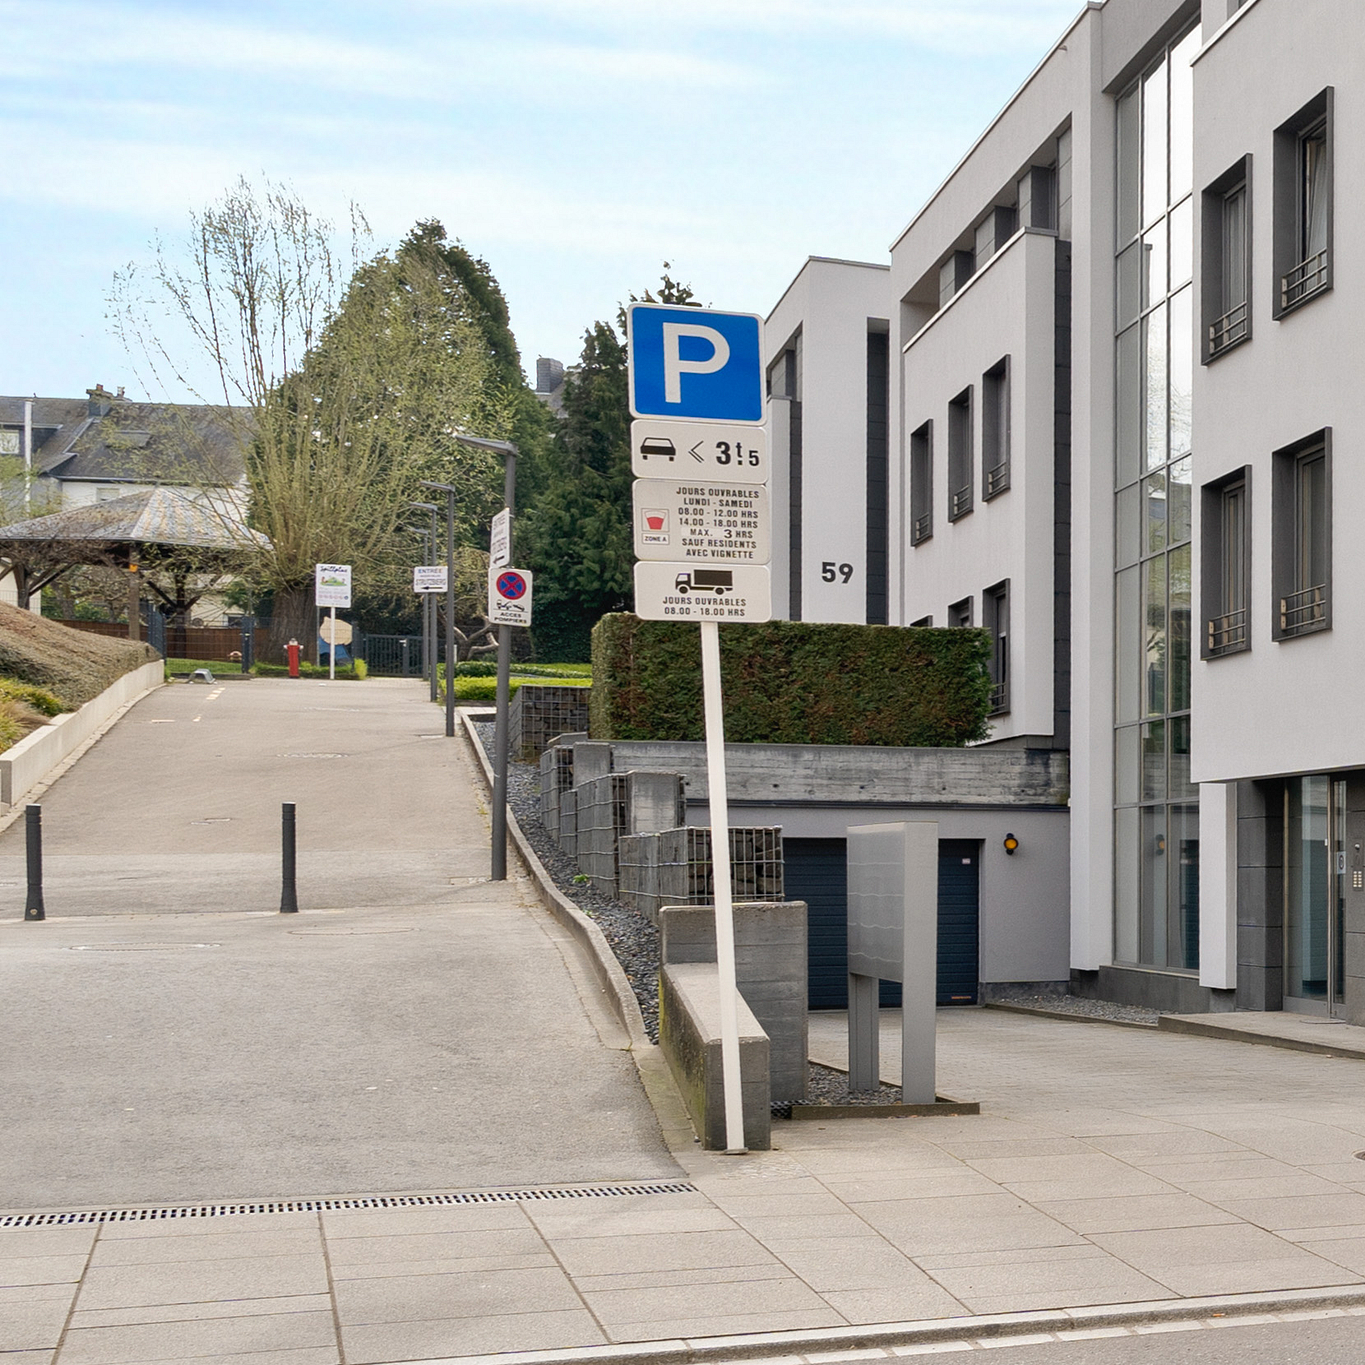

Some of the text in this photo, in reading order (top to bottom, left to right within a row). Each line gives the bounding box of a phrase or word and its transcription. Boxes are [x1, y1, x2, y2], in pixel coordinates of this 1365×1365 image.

[663, 322, 731, 403] P
[676, 487, 760, 499] JOURS OUVRABLES
[684, 498, 711, 506] LUNDI
[718, 499, 753, 508] SAMEDI
[678, 507, 704, 516] 08.00
[713, 509, 738, 518] 12.00
[741, 511, 758, 519] HRS
[679, 518, 704, 527] 14.00
[713, 519, 738, 528] 18.00
[741, 521, 758, 529] HRS
[723, 529, 733, 539] 3
[735, 531, 753, 539] HRS
[682, 538, 757, 549] SAUF RESIDENTS
[686, 549, 754, 559] AVEC VIGNETTE
[821, 561, 854, 584] 59
[662, 596, 747, 606] JOURS OUVRABLES
[664, 607, 691, 615] 08.00
[700, 607, 725, 616] 18.00
[727, 608, 746, 616] HRS
